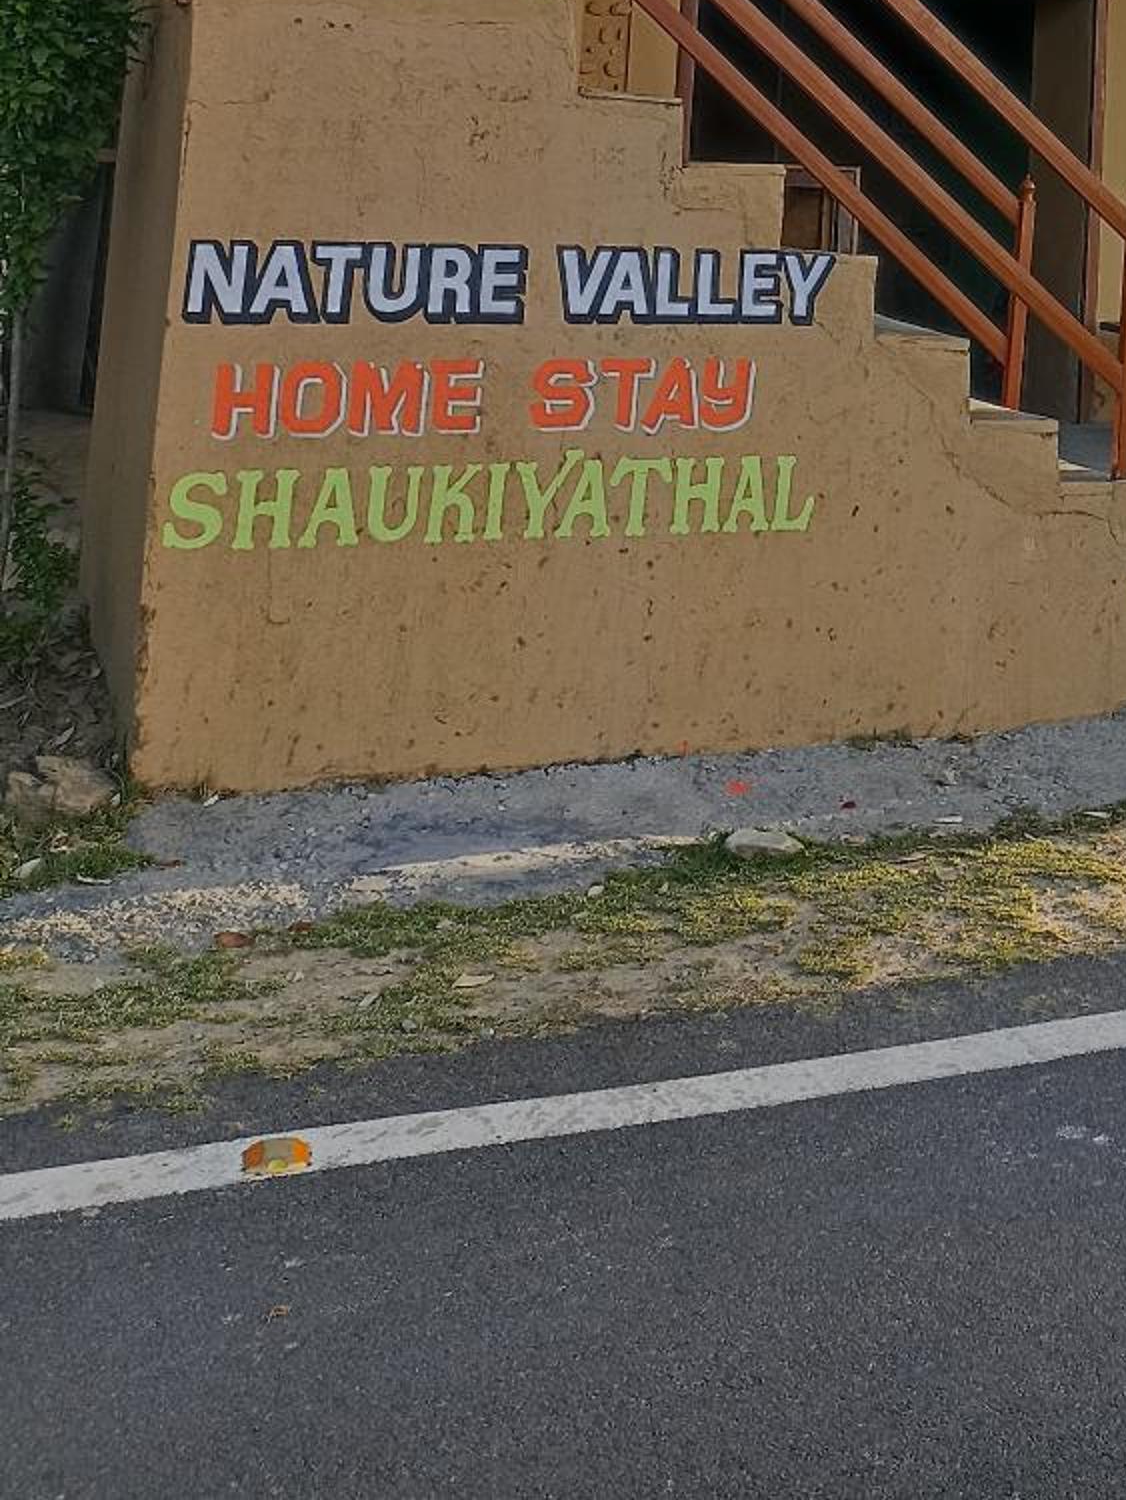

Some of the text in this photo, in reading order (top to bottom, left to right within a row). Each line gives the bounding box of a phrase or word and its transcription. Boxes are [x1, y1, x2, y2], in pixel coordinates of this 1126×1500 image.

[182, 240, 835, 326] NATURE VALLEY
[209, 356, 757, 441] HOME STAY
[161, 448, 816, 551] SHAUKIYATHAL
